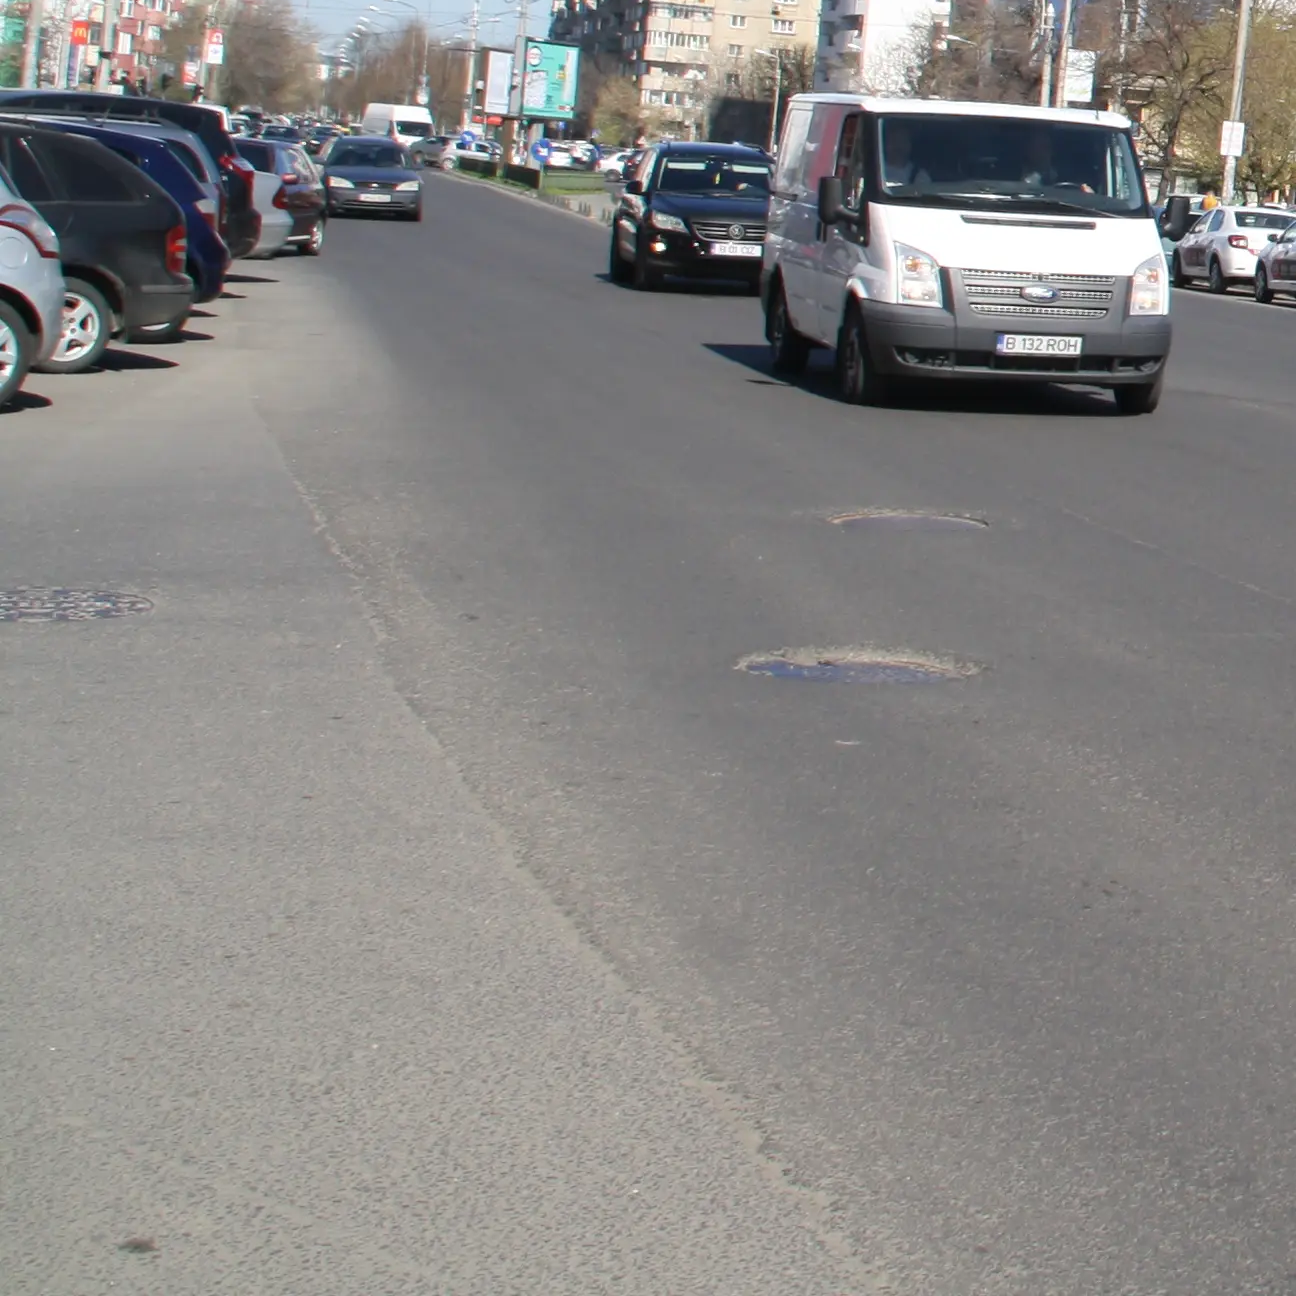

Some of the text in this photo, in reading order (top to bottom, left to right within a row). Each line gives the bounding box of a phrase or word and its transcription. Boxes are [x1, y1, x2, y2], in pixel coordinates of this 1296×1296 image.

[1005, 336, 1078, 353] B 132 ROH
